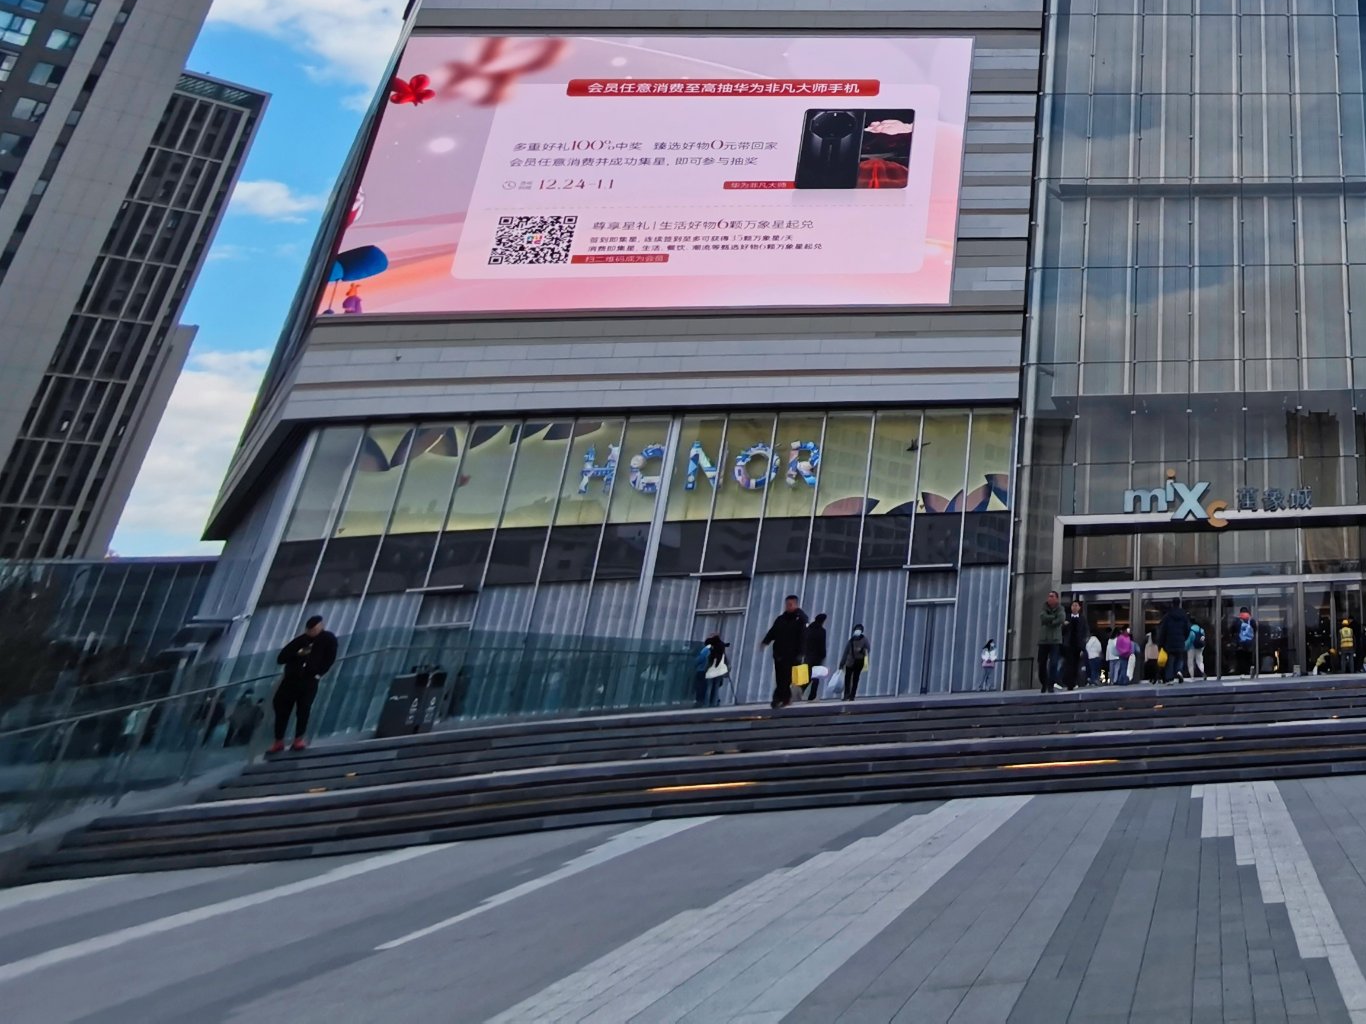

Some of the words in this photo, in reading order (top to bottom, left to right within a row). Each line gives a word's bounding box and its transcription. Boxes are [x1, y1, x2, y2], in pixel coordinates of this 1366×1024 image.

[587, 82, 860, 94] 会员任意消费至高抽华为非凡大师手机
[577, 440, 820, 494] HONOR
